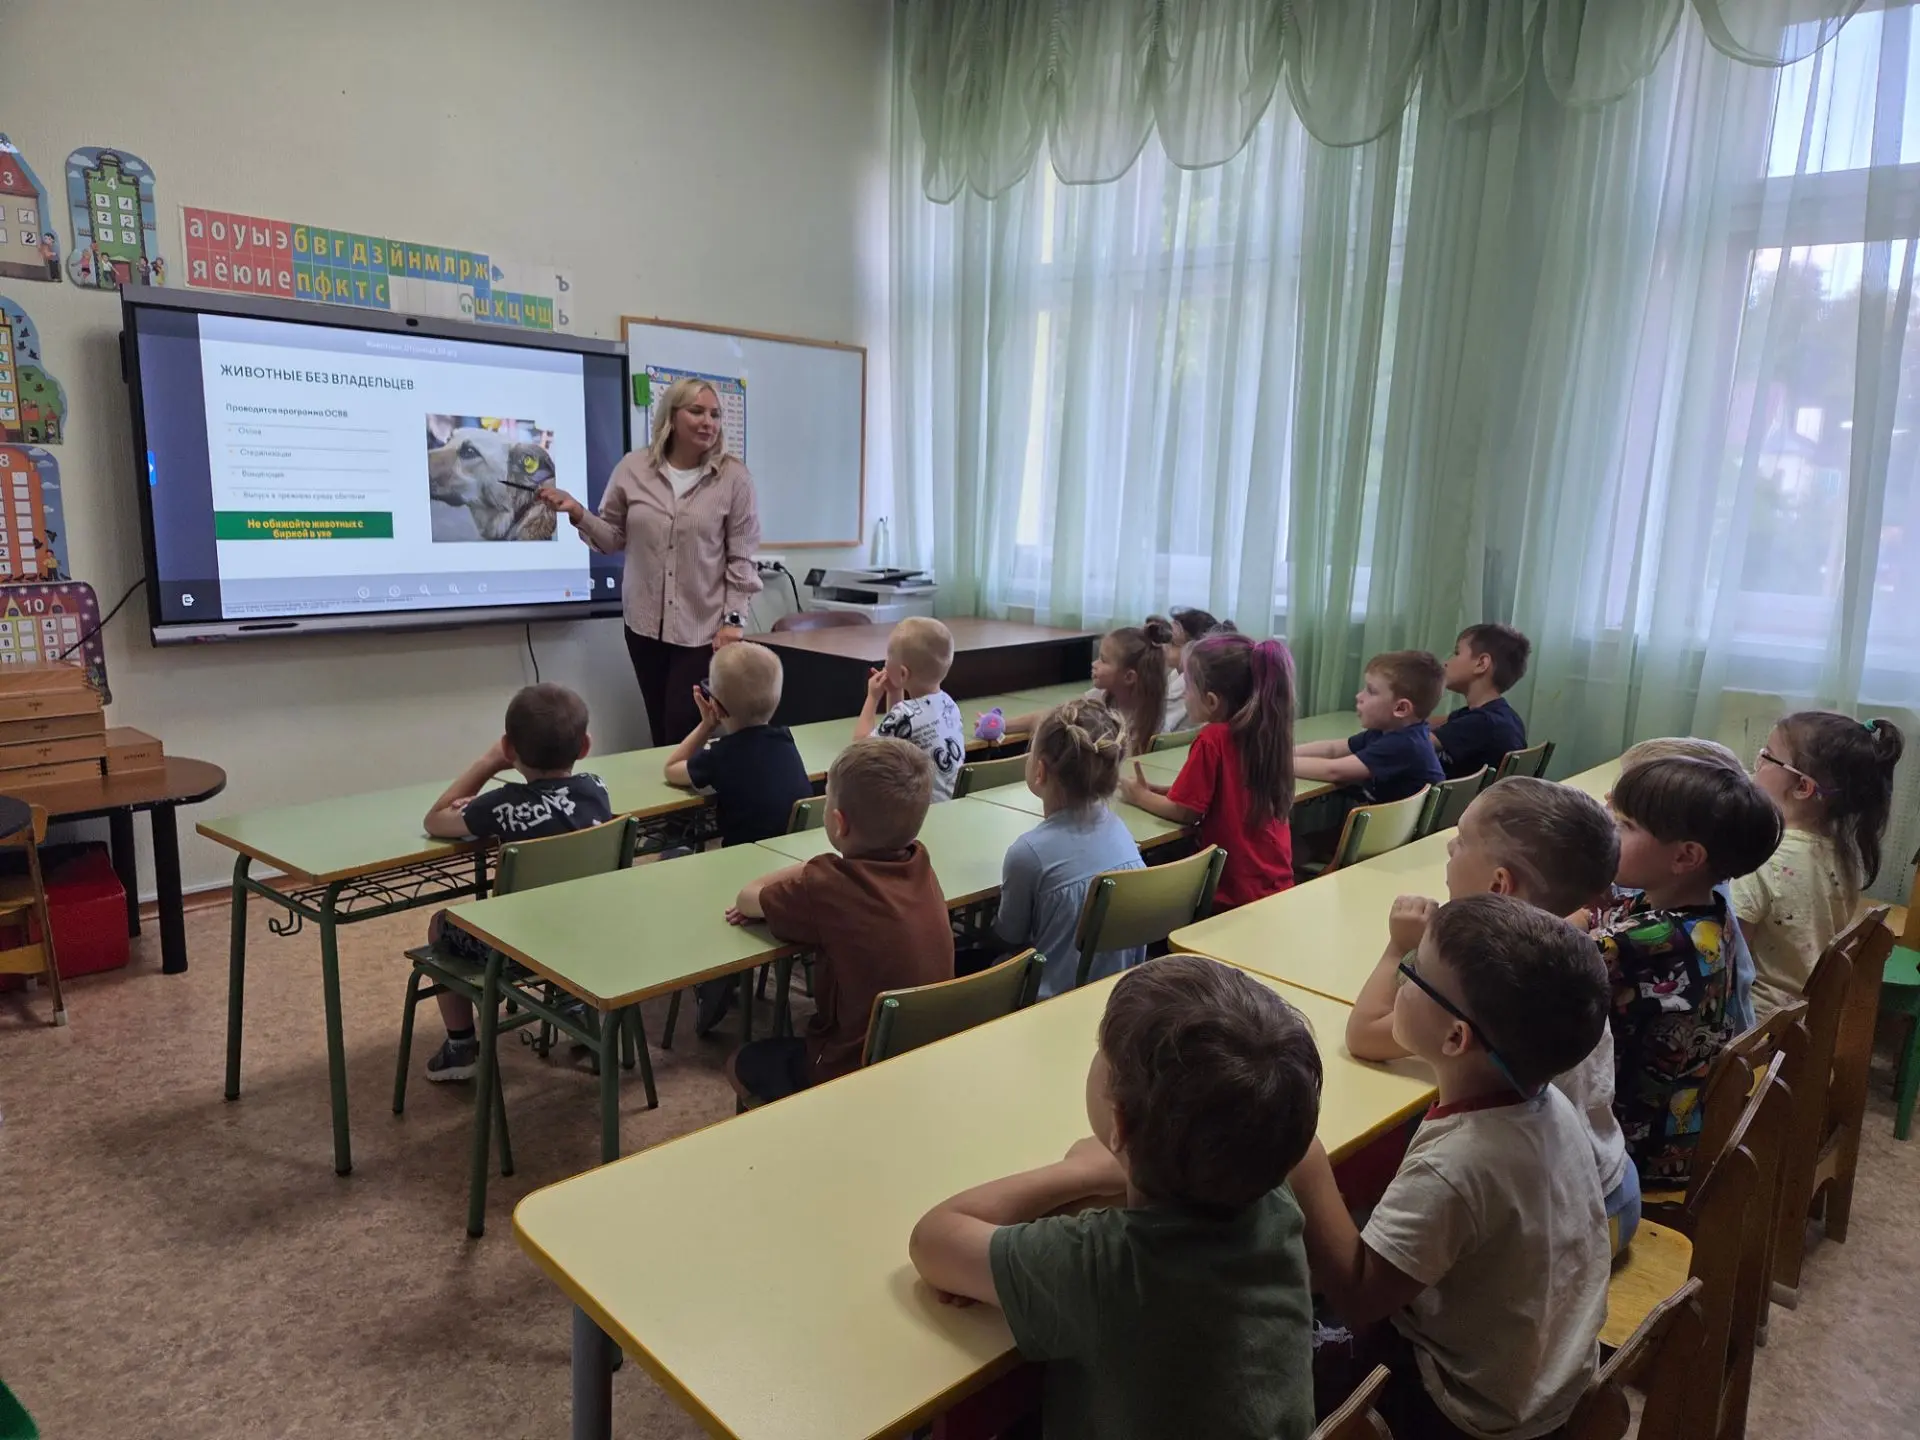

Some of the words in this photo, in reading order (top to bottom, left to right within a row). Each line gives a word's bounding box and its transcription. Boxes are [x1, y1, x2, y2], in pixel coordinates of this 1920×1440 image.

[3, 171, 13, 186] 3
[107, 178, 117, 191] 4
[25, 232, 35, 244] 2
[220, 364, 302, 382] ЖИВОТНЫЕ
[306, 372, 329, 384] БЕЗ
[332, 373, 414, 391] ВЛАДЕЛЬЦЕВ
[226, 403, 277, 415] Проводится
[278, 407, 323, 418] программа
[0, 454, 9, 467] 8
[247, 519, 261, 528] Не
[263, 518, 310, 528] обижайте
[312, 520, 357, 528] животных
[273, 528, 308, 539] биркой
[24, 599, 44, 613] 10
